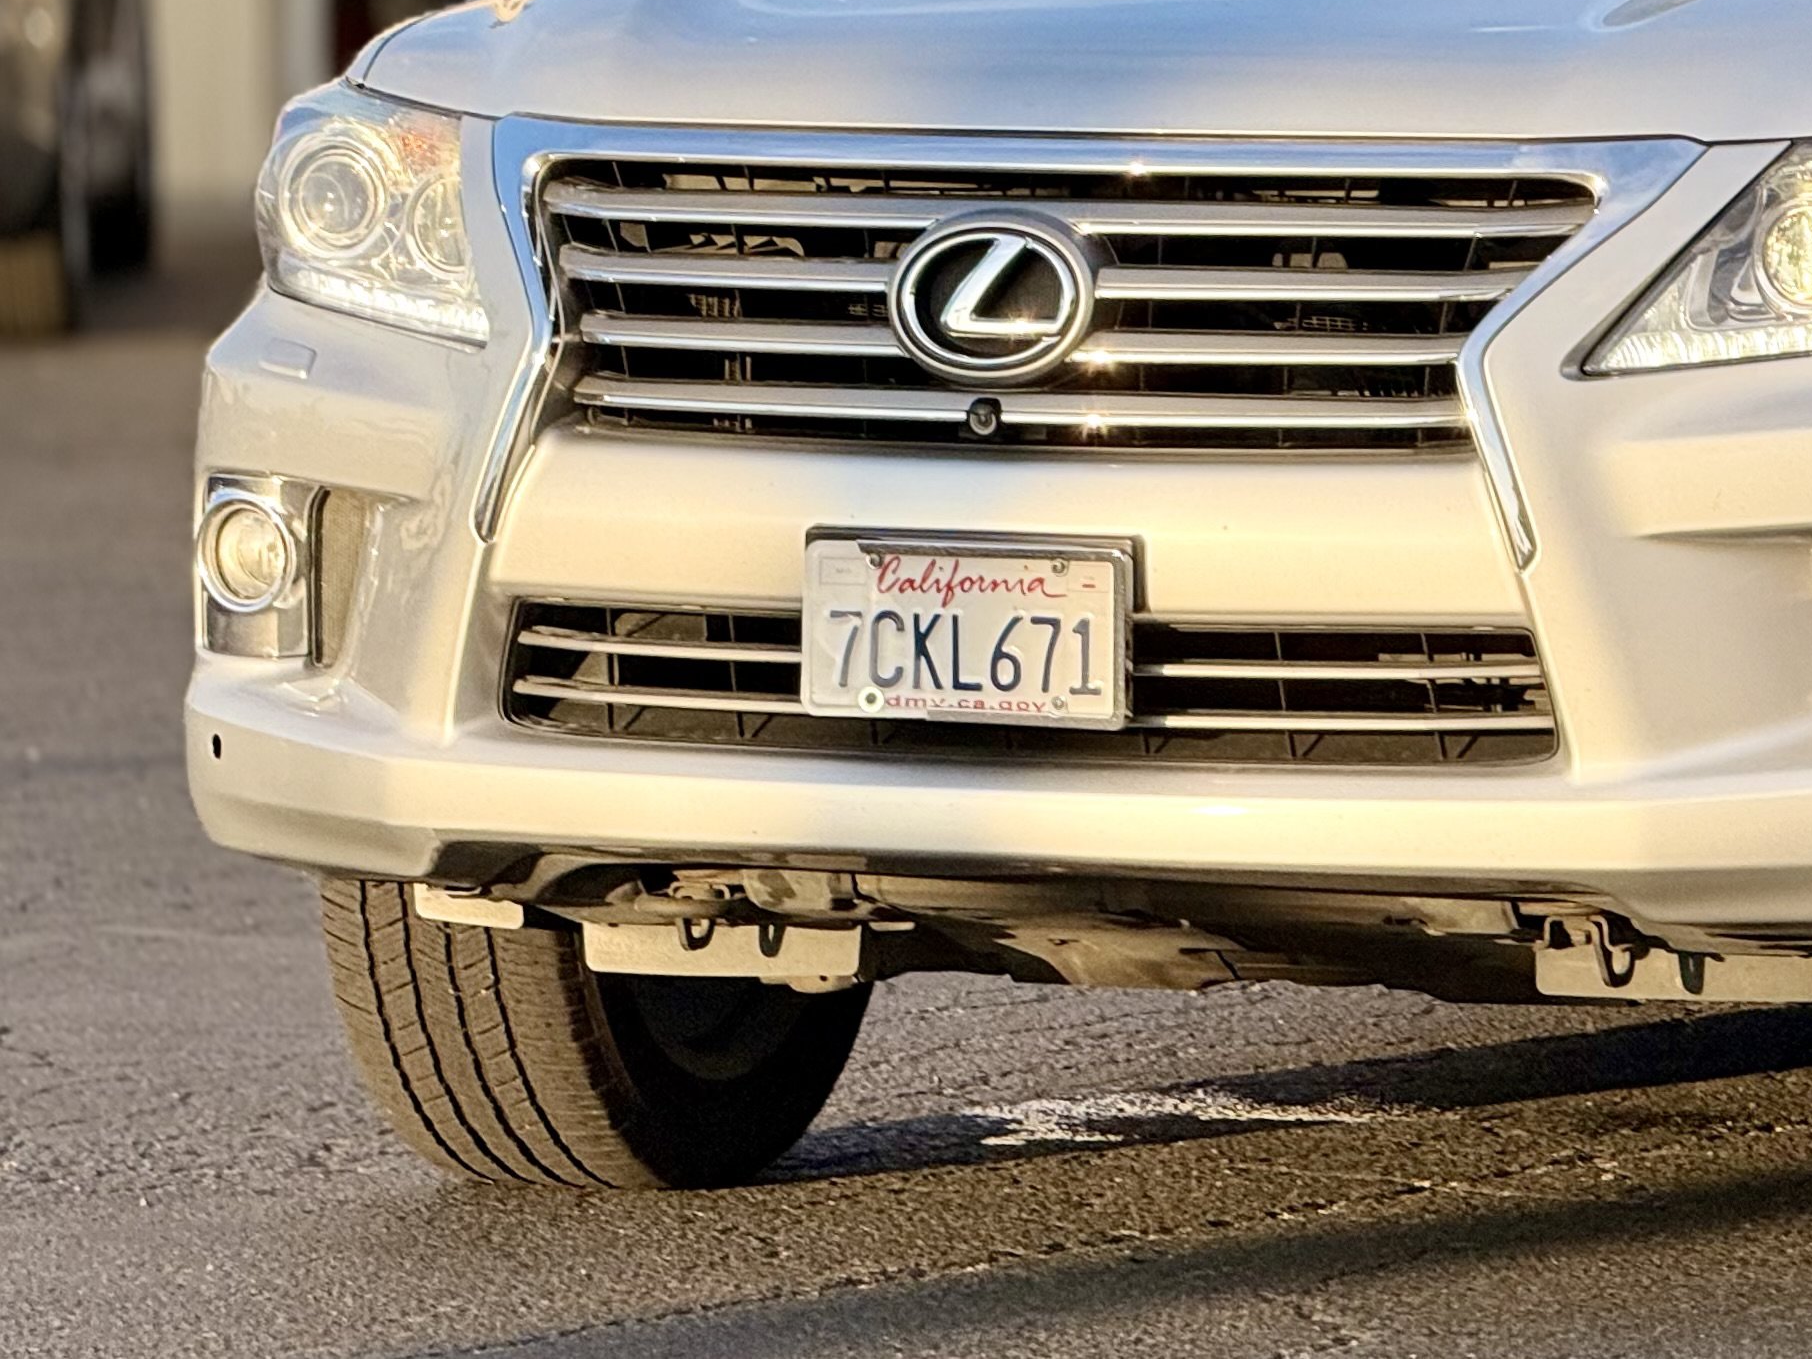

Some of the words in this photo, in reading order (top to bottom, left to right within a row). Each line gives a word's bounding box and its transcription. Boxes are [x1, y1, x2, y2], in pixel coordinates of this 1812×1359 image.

[876, 555, 1067, 608] California
[829, 609, 1102, 696] 7CKL671
[885, 695, 1046, 713] dmv.ca.gov
